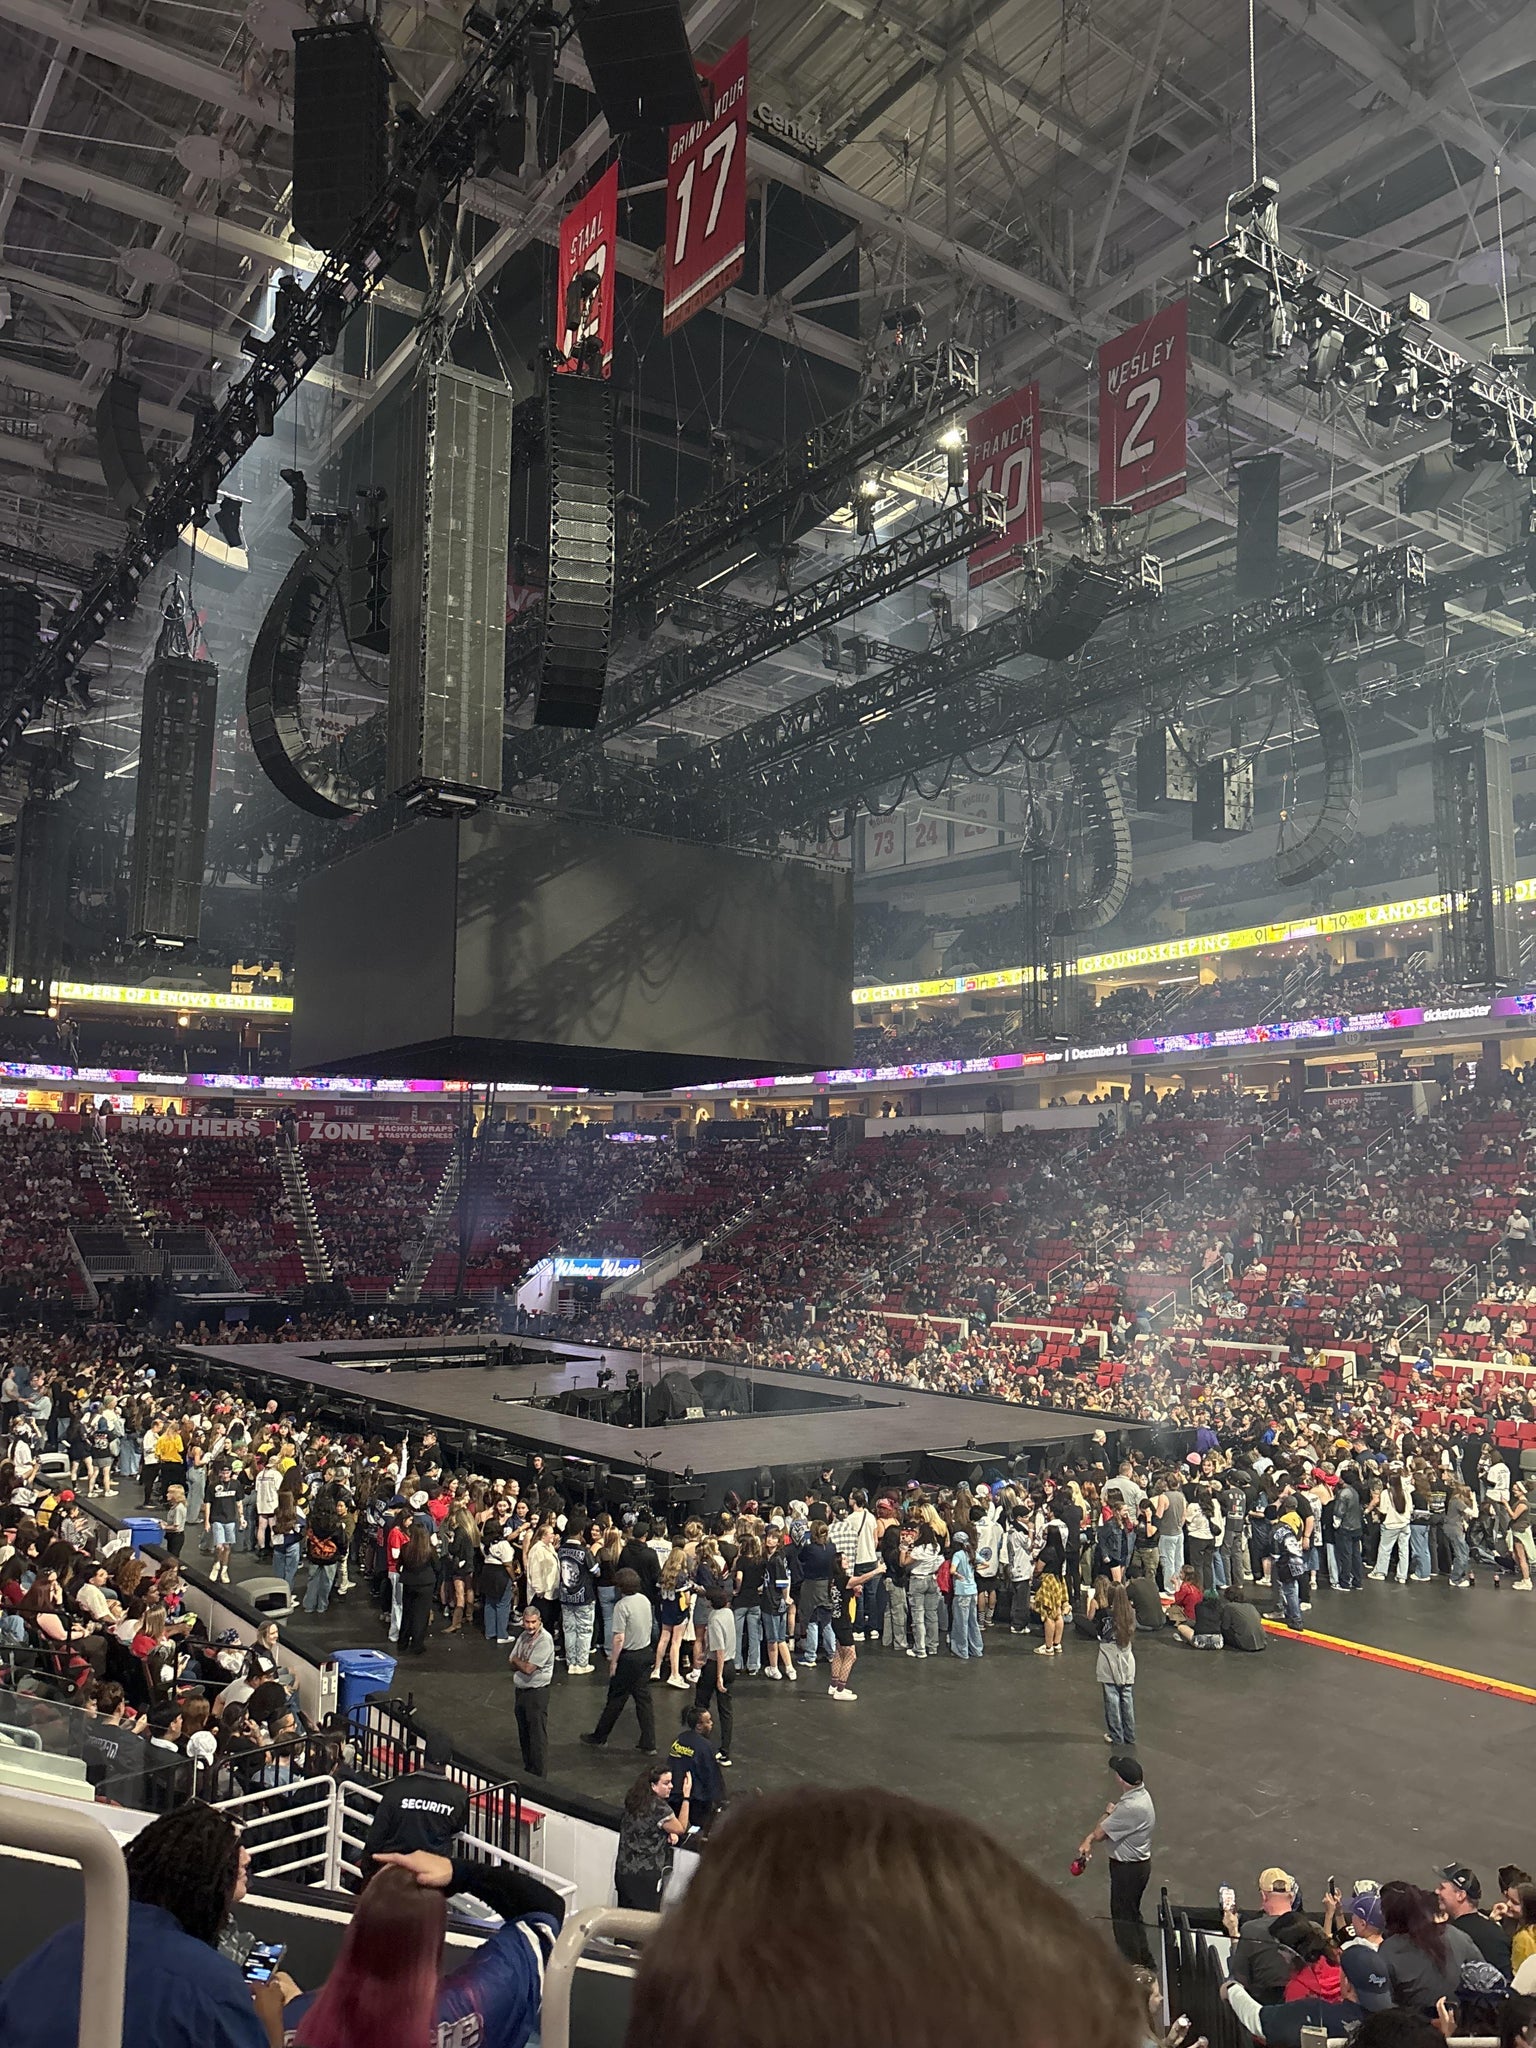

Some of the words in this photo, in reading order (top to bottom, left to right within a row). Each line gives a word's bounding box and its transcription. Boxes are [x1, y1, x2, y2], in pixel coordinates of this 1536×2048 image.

[758, 102, 821, 153] Center
[673, 120, 737, 266] 17
[569, 210, 604, 265] STAAL
[1107, 335, 1176, 394] WESLEY
[1119, 377, 1162, 468] 2
[973, 415, 1034, 465] FRANCIS
[873, 830, 895, 857] 73
[915, 821, 938, 849] 24
[1082, 935, 1231, 970] GROUNDSKEEPING
[125, 988, 146, 1001] OF
[149, 990, 211, 1006] LENOVO
[215, 993, 273, 1009] CENTER
[872, 984, 921, 1000] CENTER
[1423, 1004, 1492, 1023] ticketmaster
[1071, 1046, 1116, 1060] December
[1115, 1043, 1129, 1056] 11
[334, 1105, 355, 1116] THE
[120, 1116, 260, 1137] BROTHERS
[309, 1122, 375, 1140] ZONE
[555, 1258, 600, 1276] Window
[601, 1258, 640, 1277] World
[401, 1798, 455, 1816] SECURITY
